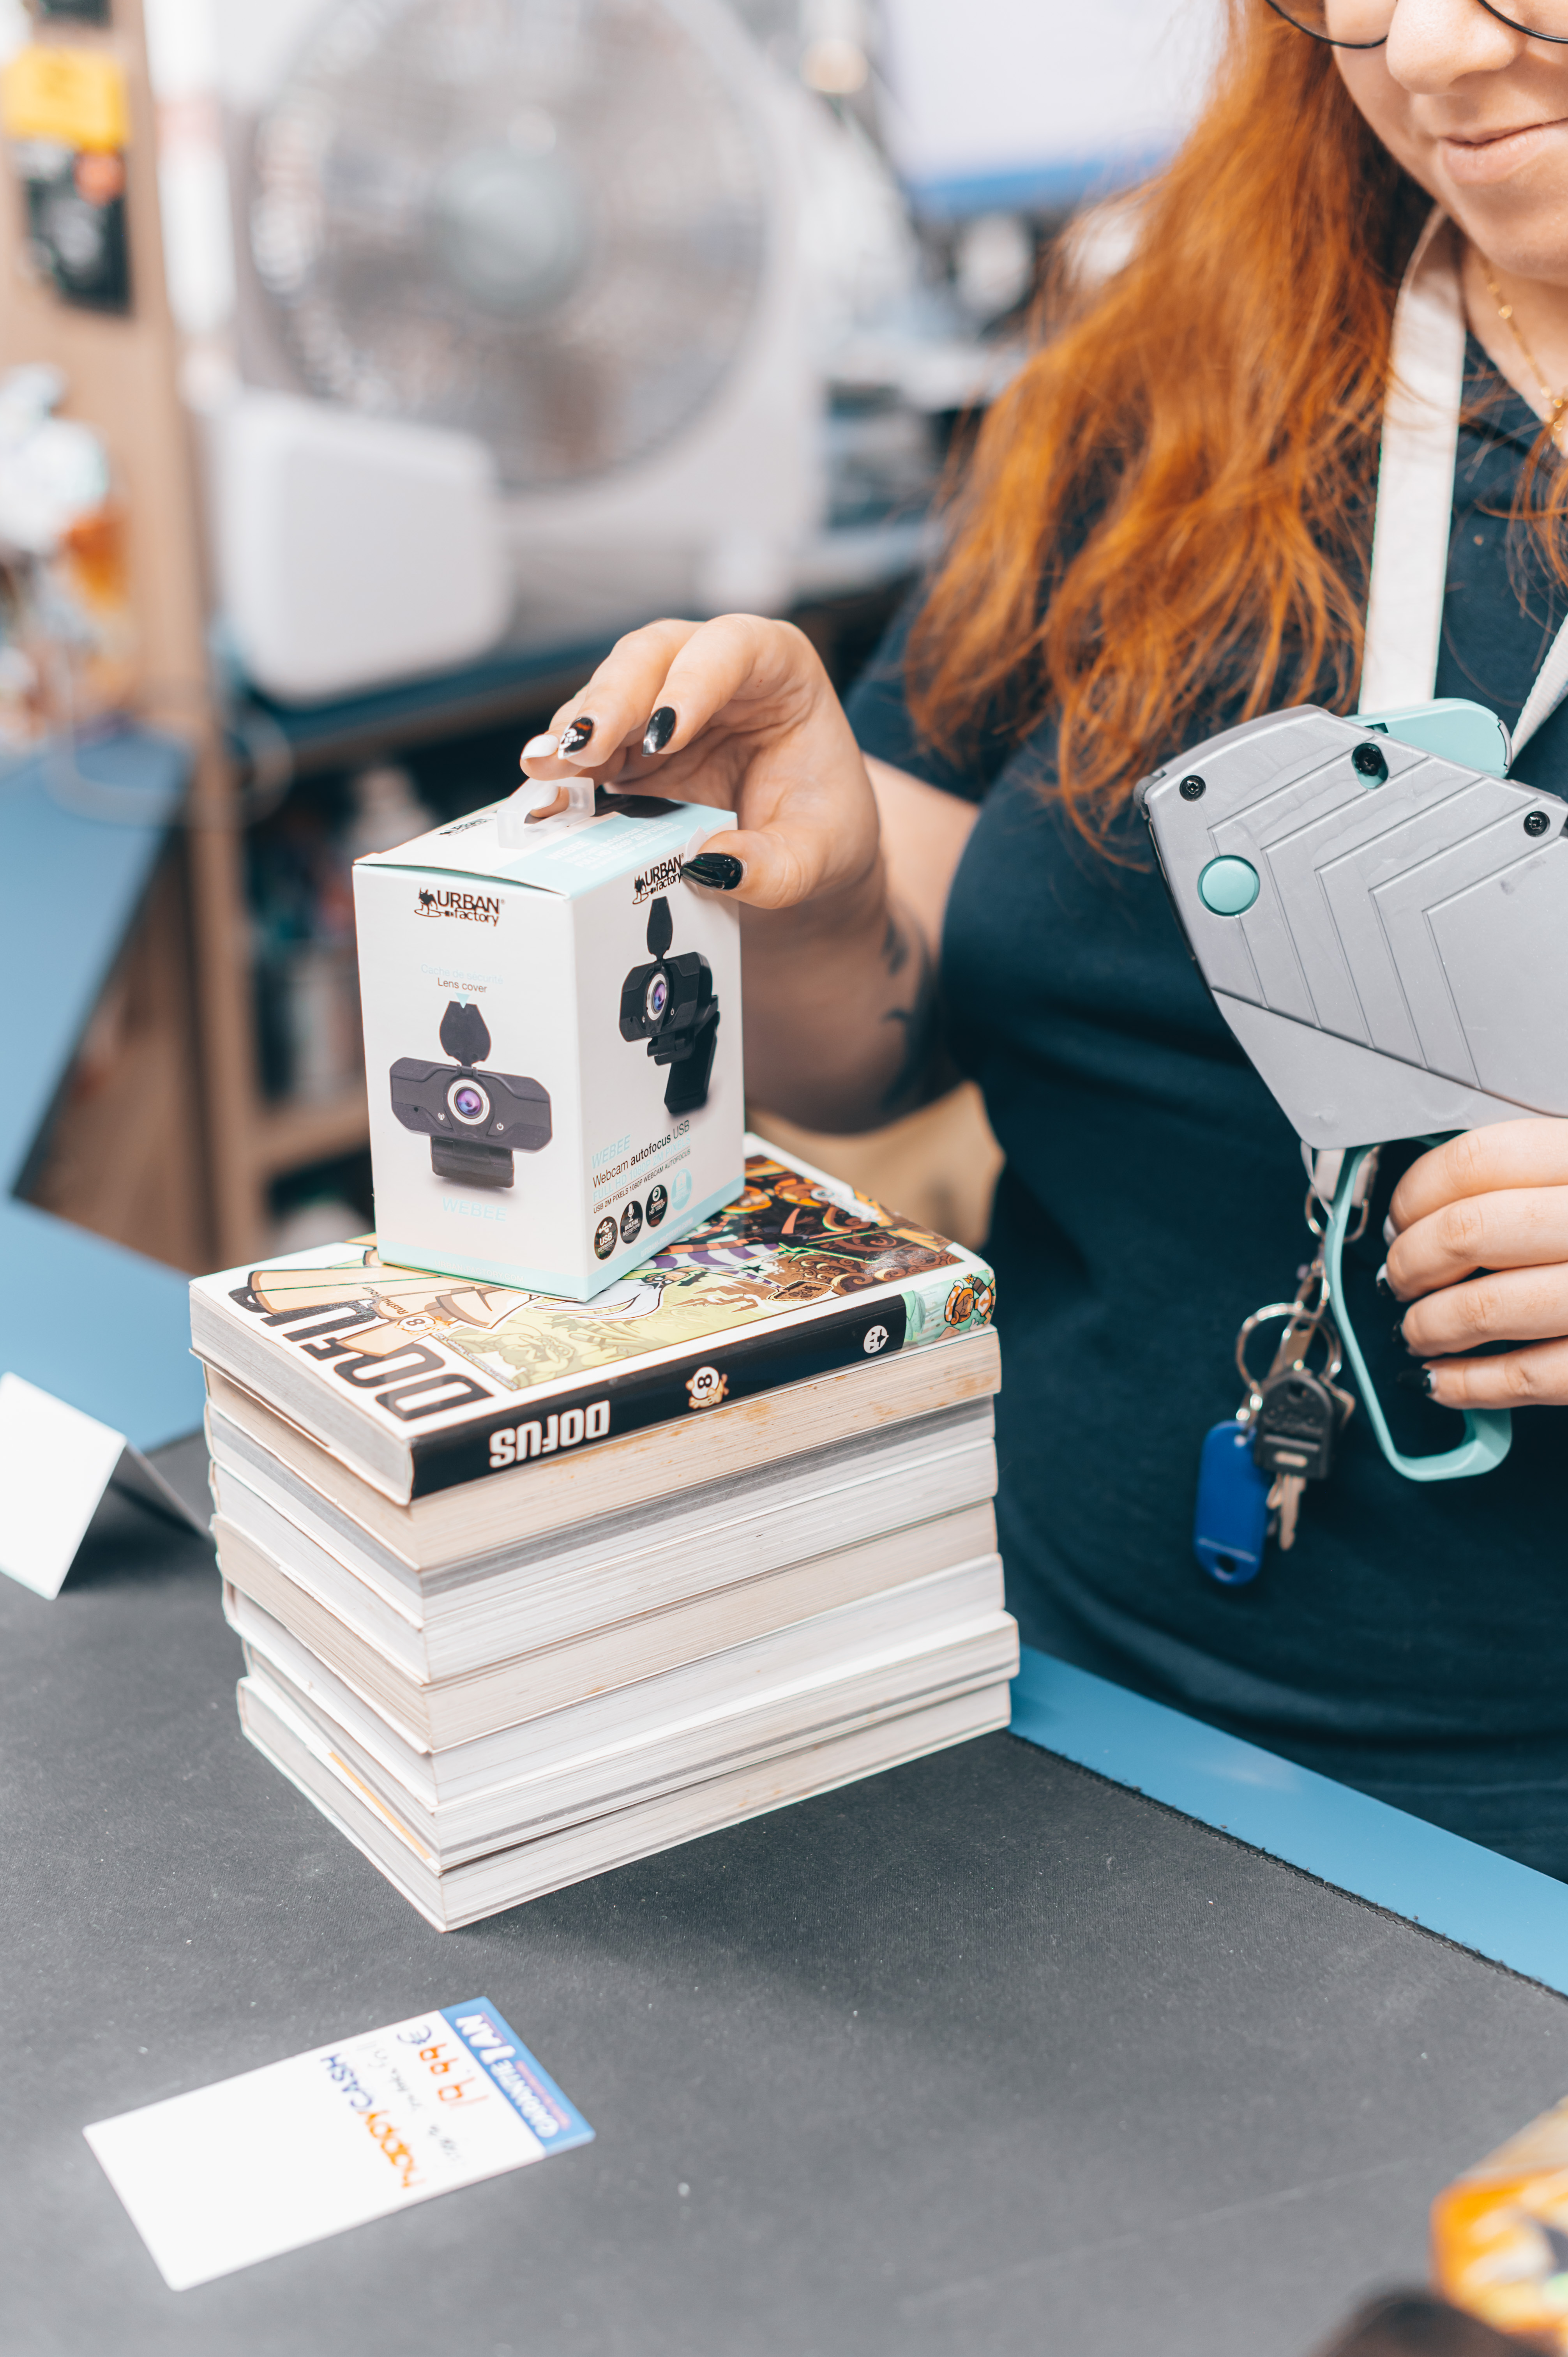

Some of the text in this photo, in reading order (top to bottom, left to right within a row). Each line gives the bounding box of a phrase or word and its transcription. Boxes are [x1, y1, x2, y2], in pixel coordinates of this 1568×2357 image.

[600, 827, 644, 848] autofocus
[637, 819, 661, 829] USB
[643, 821, 674, 835] PIXELS
[546, 840, 591, 860] WEBEE
[655, 873, 683, 892] factory
[454, 907, 500, 927] factory
[421, 963, 503, 985] Cache de sécurité
[437, 977, 488, 993] Lens cover
[592, 1134, 630, 1168] WEBEE
[593, 1120, 690, 1188] Webcam autofocus USB
[593, 1133, 690, 1202] FULL HD 1080P 2M PIXELS
[593, 1148, 690, 1214] USB 2M PIXELS 1080P WEBCAM AUTOFOCUS
[442, 1197, 508, 1222] WEBEE
[651, 1199, 663, 1209] Camera
[655, 1201, 665, 1212] 1080P
[623, 1223, 640, 1237] Microphone
[625, 1219, 638, 1231] BUILT-IN
[598, 1239, 614, 1252] connection
[599, 1232, 613, 1246] USB
[434, 1260, 524, 1283] URBAN-FACTORY.COM
[362, 1286, 409, 1315] Rushu Hour
[489, 1400, 610, 1468] DOFUS
[455, 2014, 503, 2047] AN
